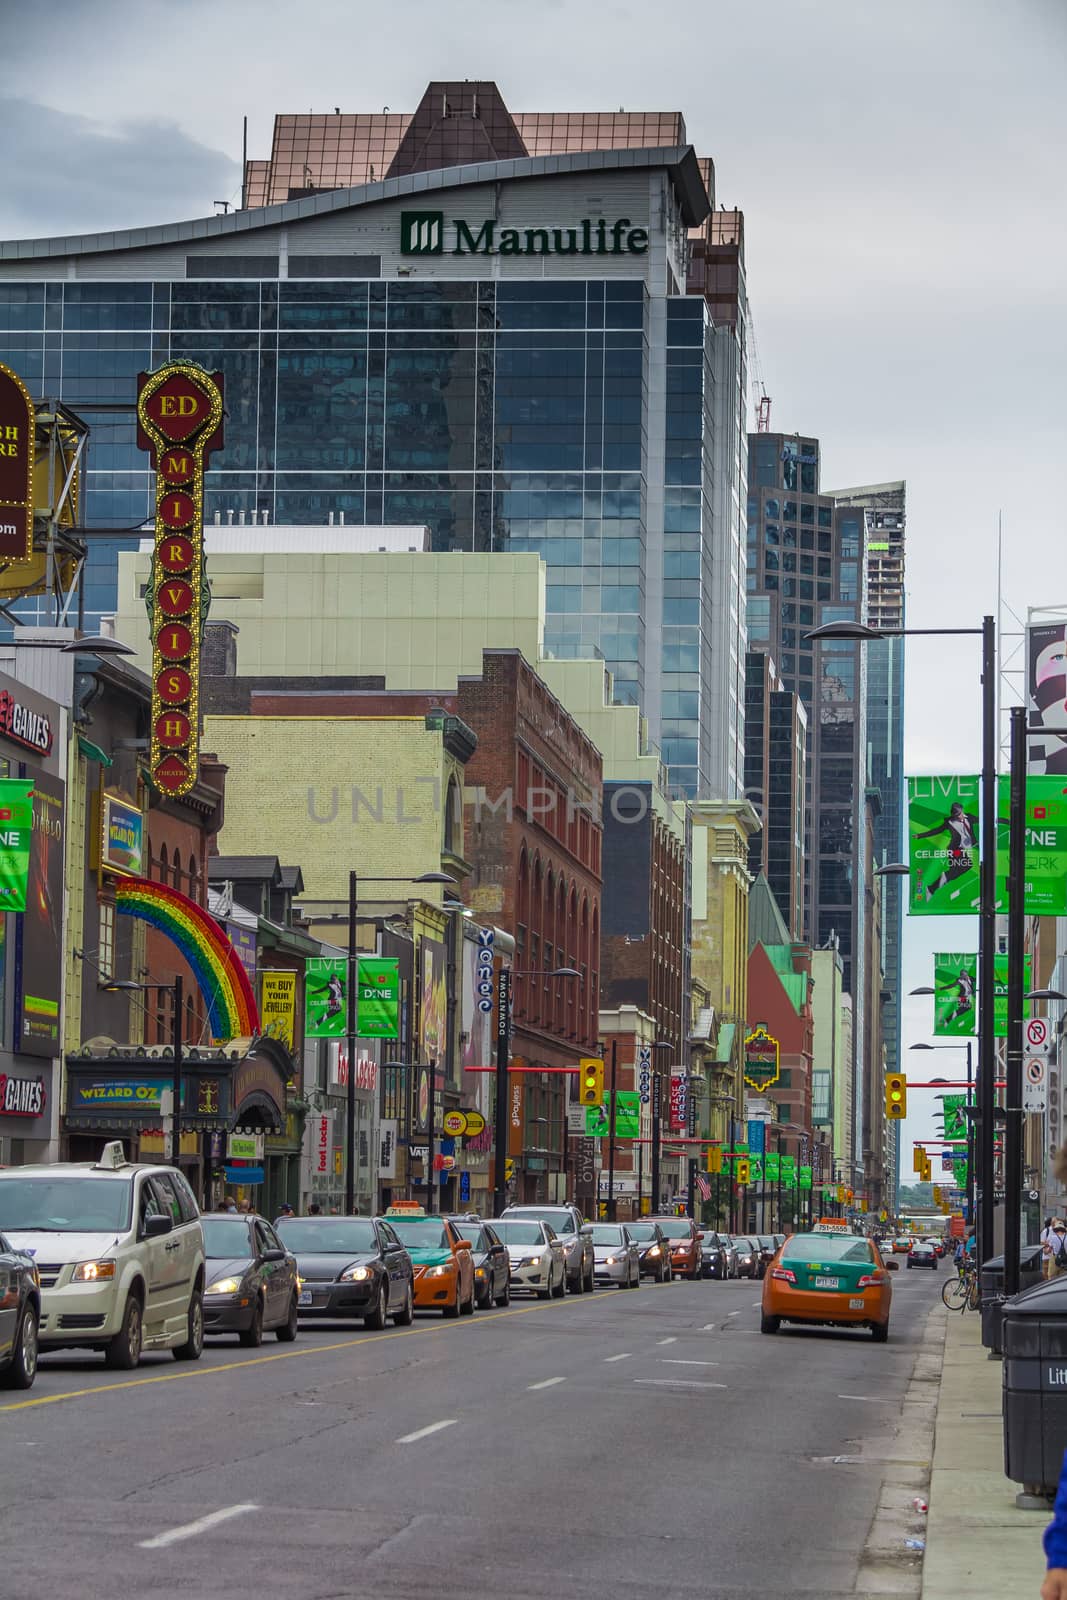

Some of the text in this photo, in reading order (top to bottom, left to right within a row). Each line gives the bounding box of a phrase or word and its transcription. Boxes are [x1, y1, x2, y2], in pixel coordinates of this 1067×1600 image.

[452, 218, 648, 256] Manulife
[160, 396, 199, 417] ED
[164, 457, 188, 737] MIRVISH
[13, 703, 49, 749] GAMES
[914, 776, 974, 798] LIVE
[265, 980, 293, 991] WE BUY
[478, 928, 493, 1013] Yonge
[264, 1002, 292, 1013] JEWELLERY
[268, 992, 289, 1000] YOUR
[5, 1079, 42, 1113] GAMES
[80, 1086, 158, 1100] WIZARD OZ
[512, 1085, 520, 1118] Payless
[1049, 1071, 1058, 1161] ROOTS
